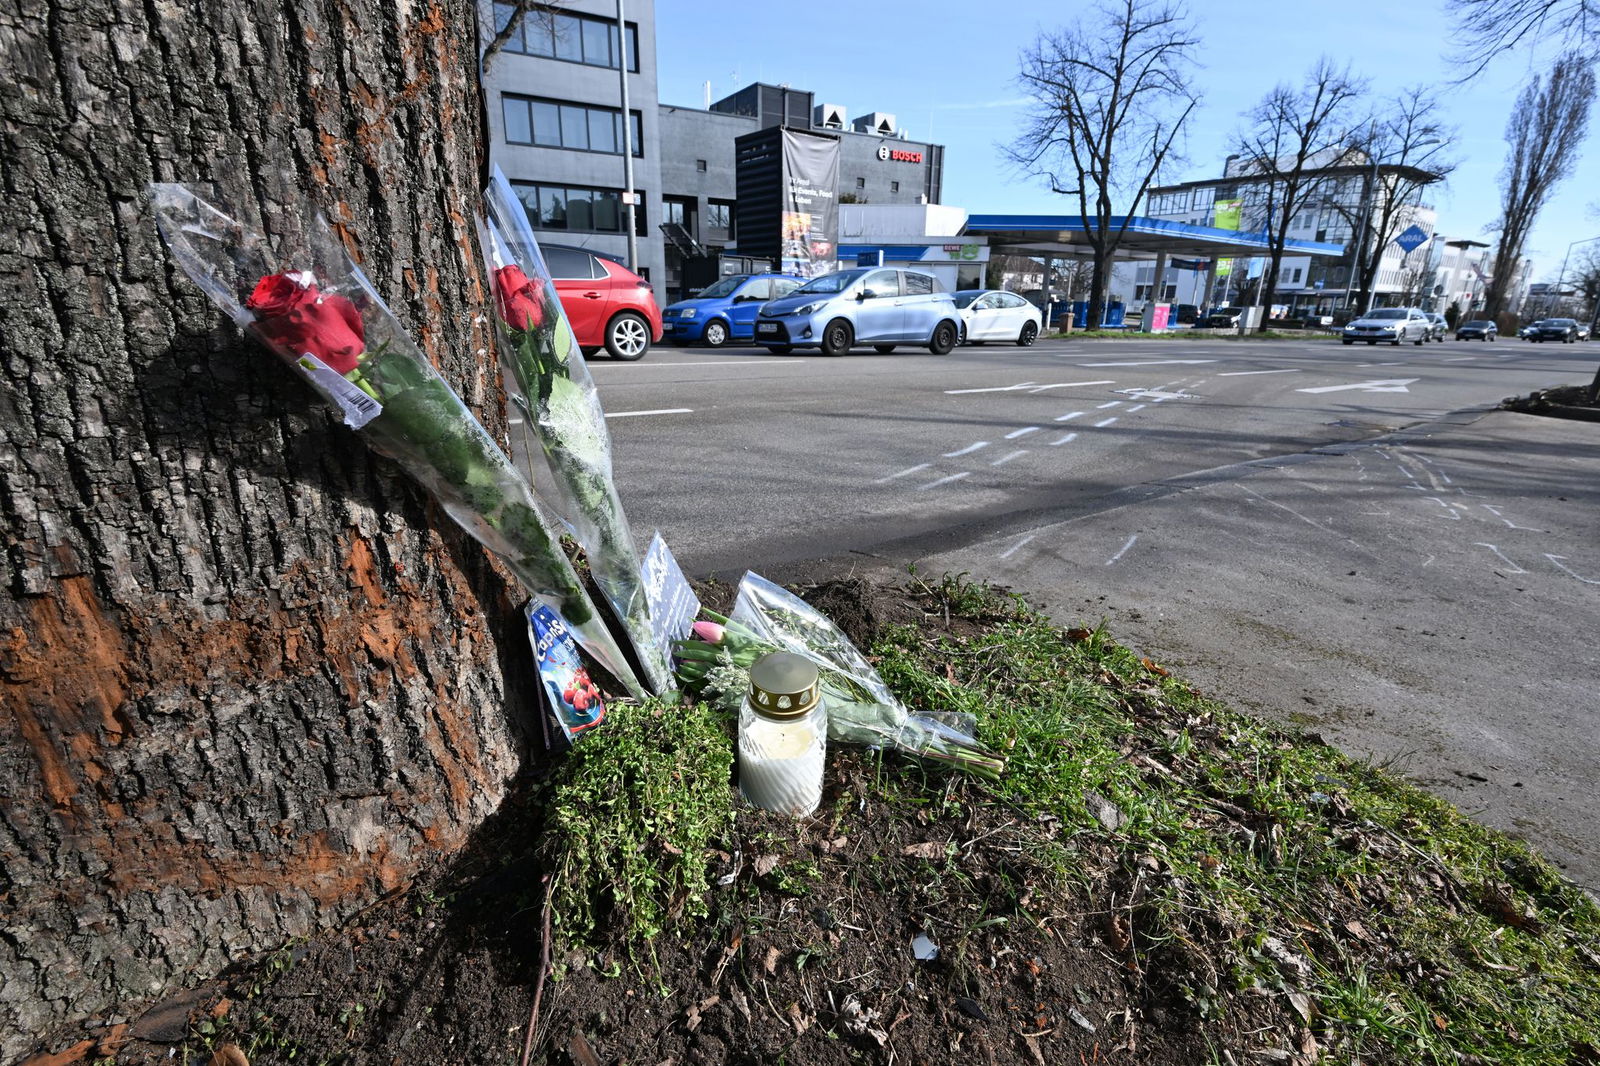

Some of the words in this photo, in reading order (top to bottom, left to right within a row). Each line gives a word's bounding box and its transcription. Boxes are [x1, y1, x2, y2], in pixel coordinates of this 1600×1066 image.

[892, 149, 922, 162] BOSCH
[819, 189, 833, 198] Food
[1399, 234, 1423, 242] ARAL
